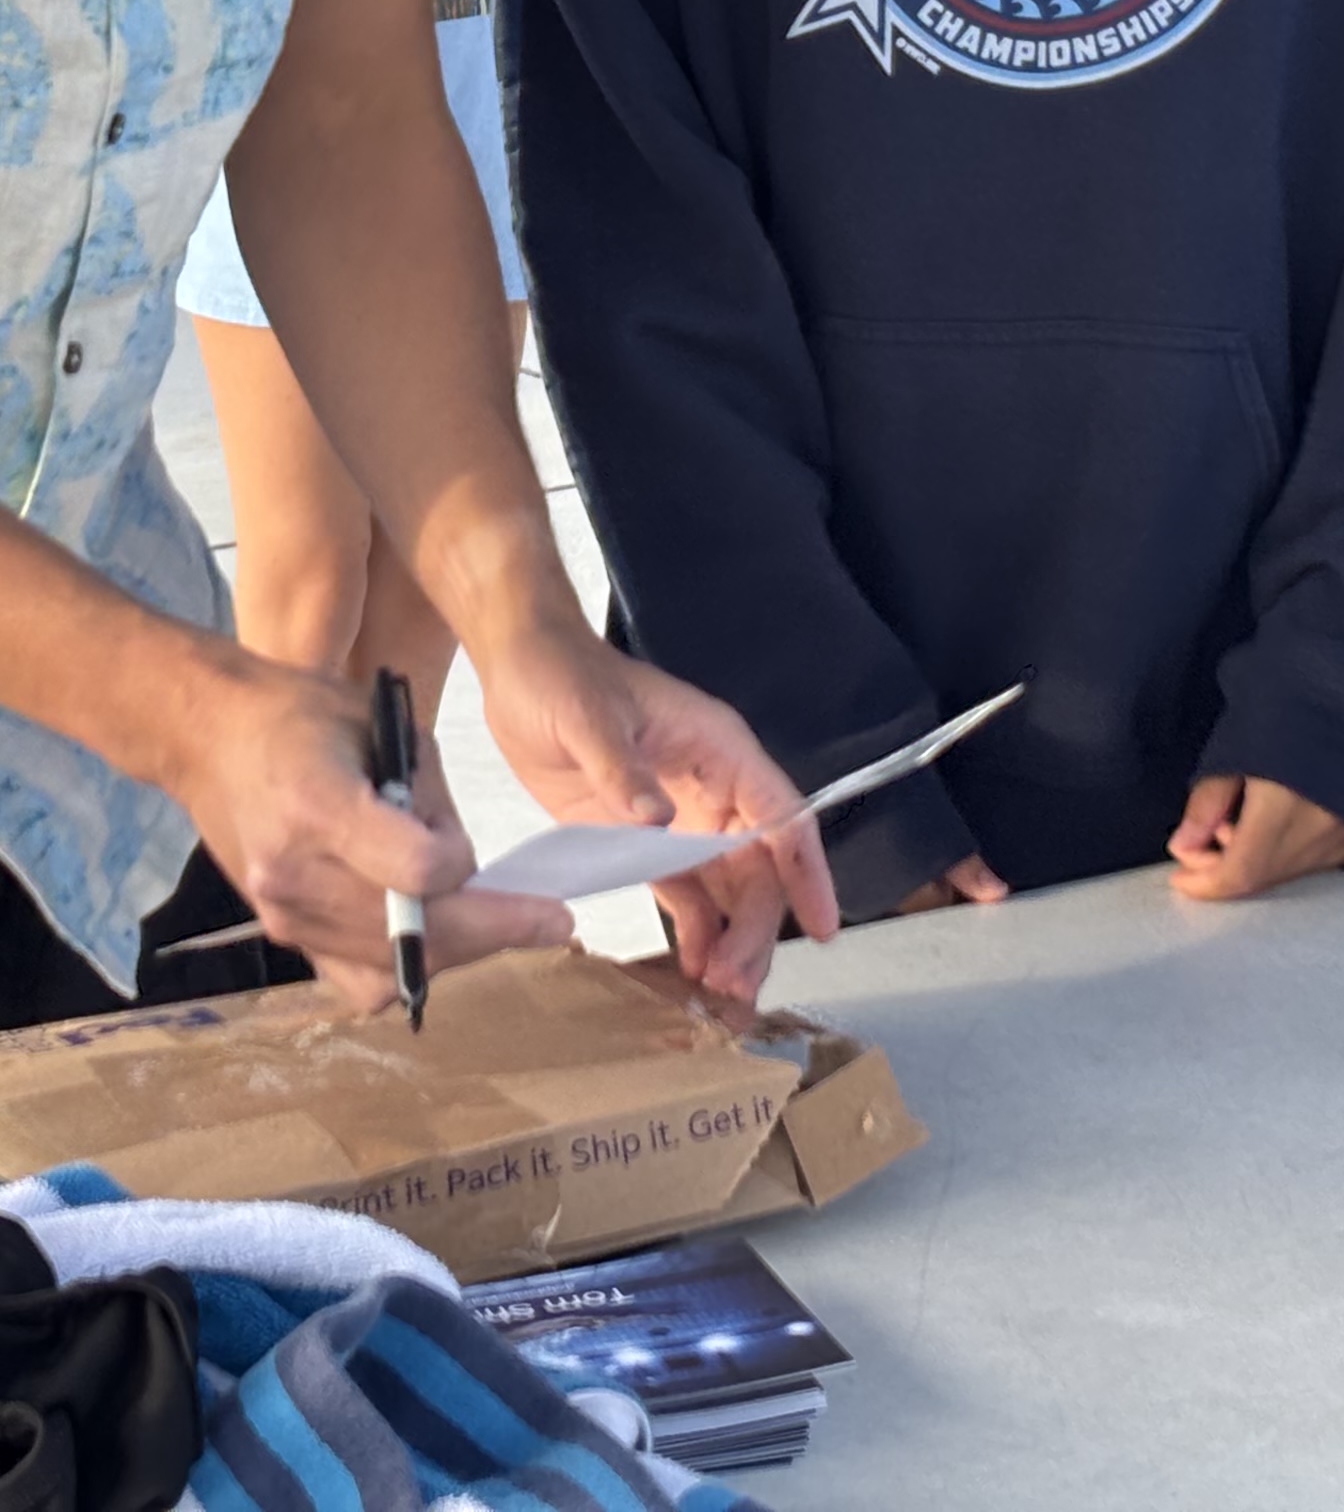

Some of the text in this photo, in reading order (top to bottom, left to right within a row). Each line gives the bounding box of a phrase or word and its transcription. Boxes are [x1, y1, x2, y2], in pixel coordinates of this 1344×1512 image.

[404, 1176, 438, 1206] it.
[446, 1153, 523, 1198] Pack
[530, 1147, 563, 1176] it.
[571, 1132, 642, 1169] Ship
[650, 1119, 681, 1151] it.
[688, 1100, 746, 1143] Get
